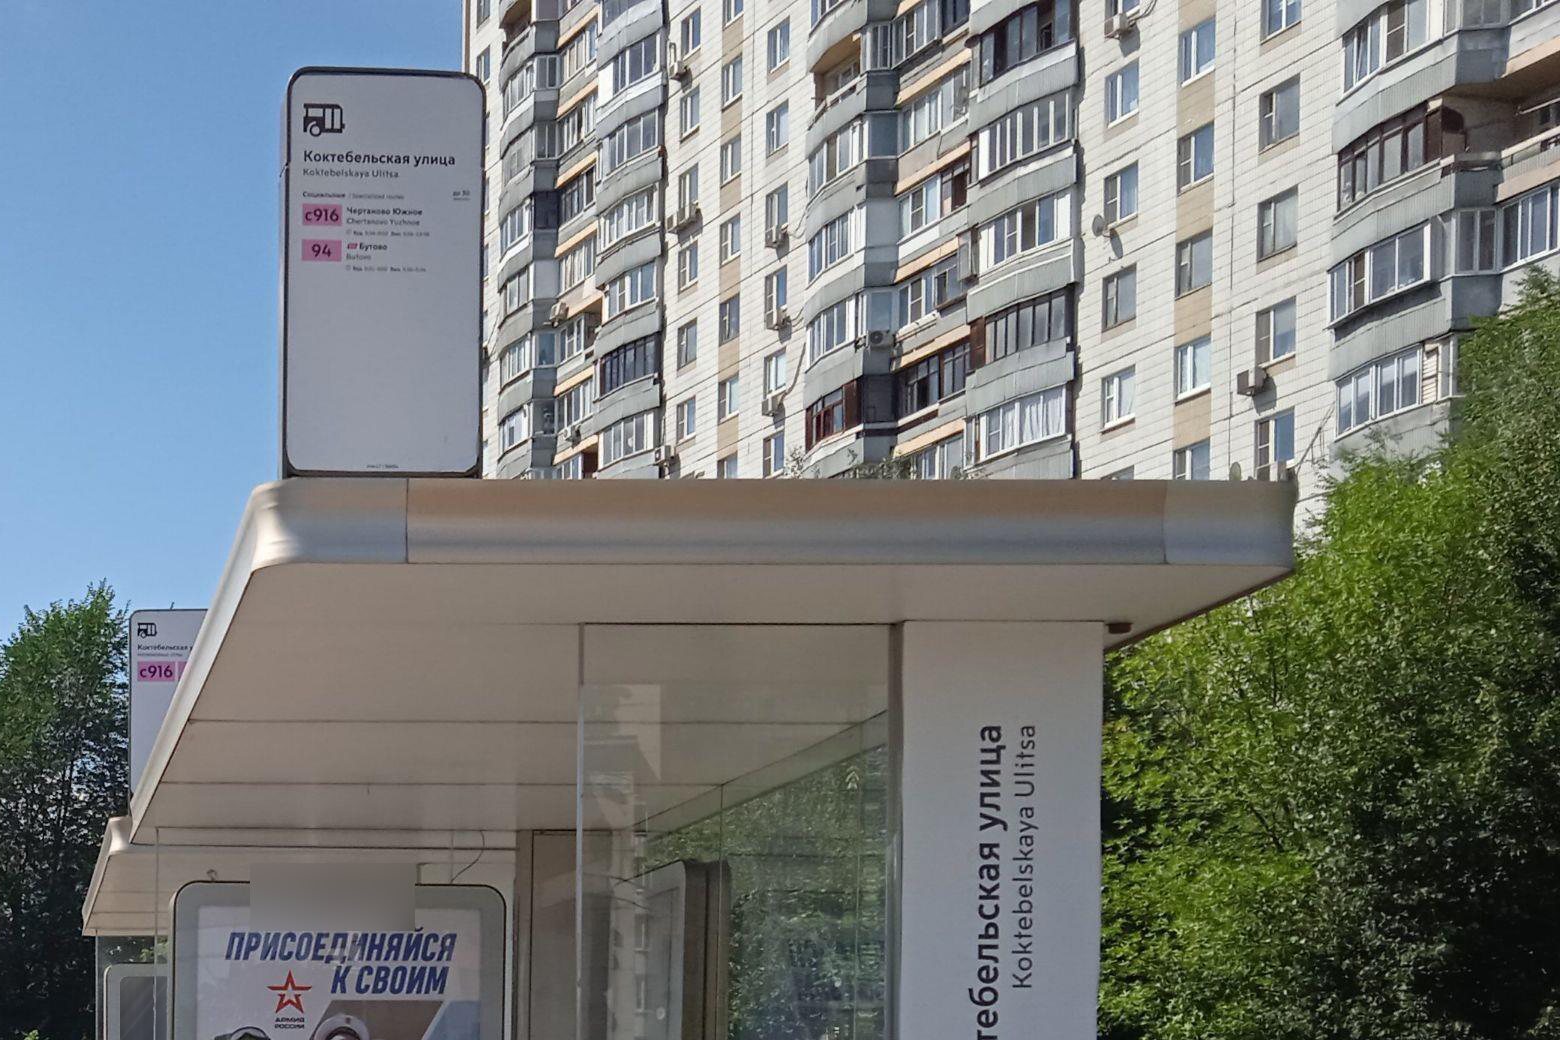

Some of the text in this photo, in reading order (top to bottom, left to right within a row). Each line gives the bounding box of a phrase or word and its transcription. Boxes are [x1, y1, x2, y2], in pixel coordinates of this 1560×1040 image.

[303, 150, 456, 168] Коктебельская улица
[303, 168, 399, 179] Koktebelskaya Ulitsa
[305, 208, 339, 222] с916
[346, 206, 423, 217] Чертаново Южное
[311, 243, 332, 258] 94
[359, 242, 388, 252] Бутово
[139, 665, 173, 679] с916
[978, 725, 1008, 832] улица
[1012, 724, 1040, 989] Koktebelskaya Ulitsa
[225, 927, 458, 964] ПРИСОЕДИНЯЙСЯ
[331, 965, 450, 995] К СВОИМ
